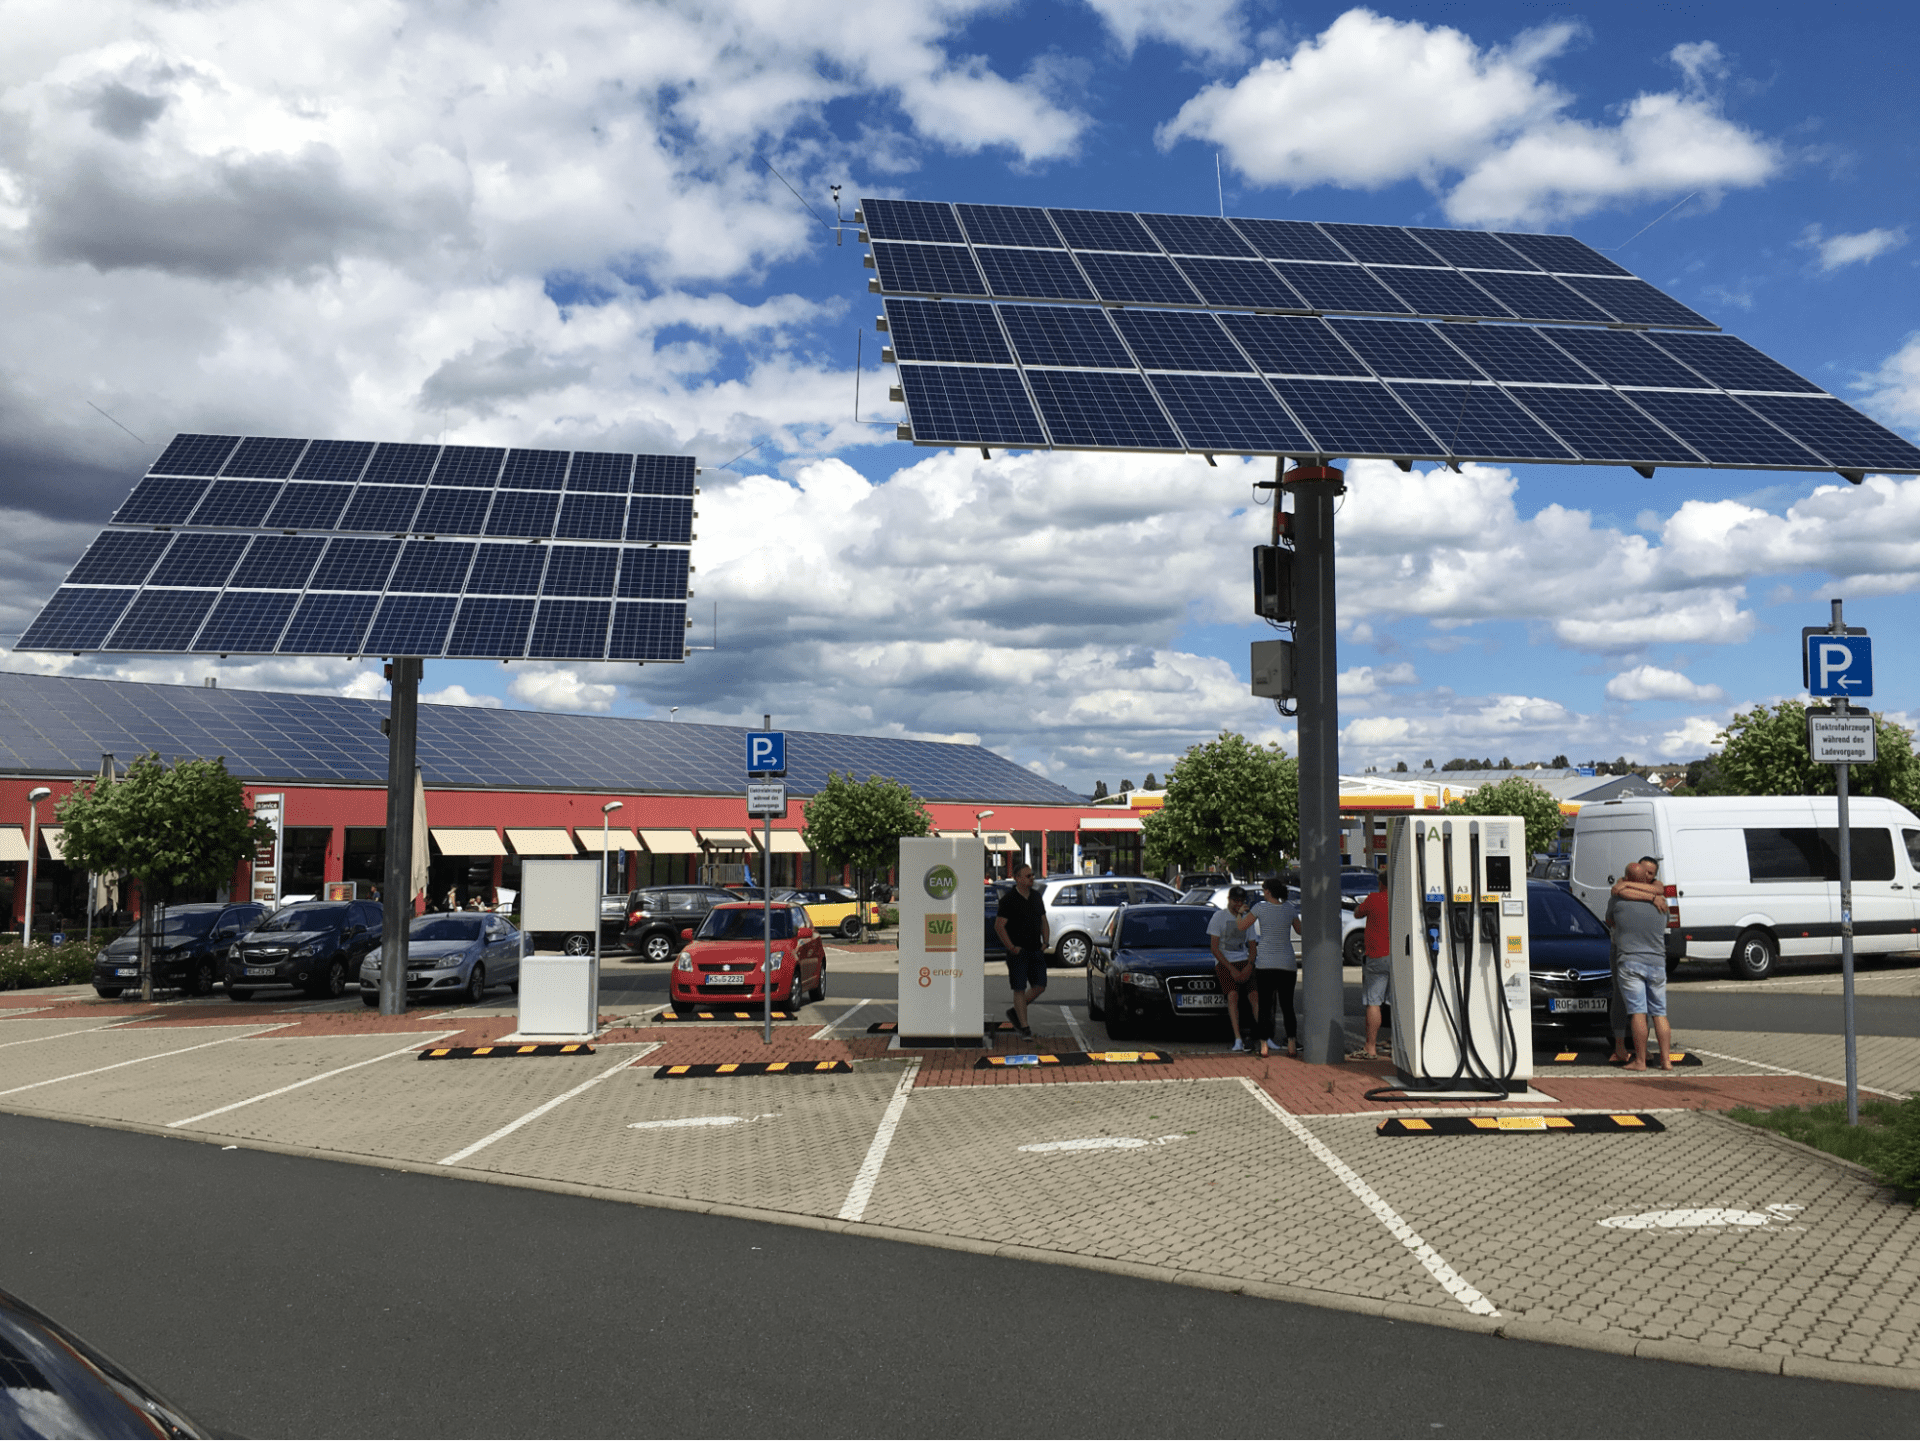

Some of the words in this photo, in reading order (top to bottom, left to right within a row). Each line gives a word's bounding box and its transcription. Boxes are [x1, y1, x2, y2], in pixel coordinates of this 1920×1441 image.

[1819, 643, 1853, 689] P
[1815, 722, 1870, 733] Elektrofahrzeuge
[1822, 735, 1851, 744] während
[1852, 735, 1865, 744] des
[752, 737, 773, 767] P
[1821, 747, 1866, 757] Ladevorgangs
[1426, 826, 1441, 842] A
[929, 877, 953, 887] EAM
[1429, 885, 1441, 893] A1
[1457, 885, 1469, 893] A3
[928, 920, 954, 934] SVG
[932, 968, 964, 978] energy
[727, 975, 744, 983] 2231
[1182, 995, 1197, 1005] HEF
[1555, 999, 1572, 1009] ROF
[1578, 999, 1590, 1009] BM
[1590, 999, 1606, 1009] 117
